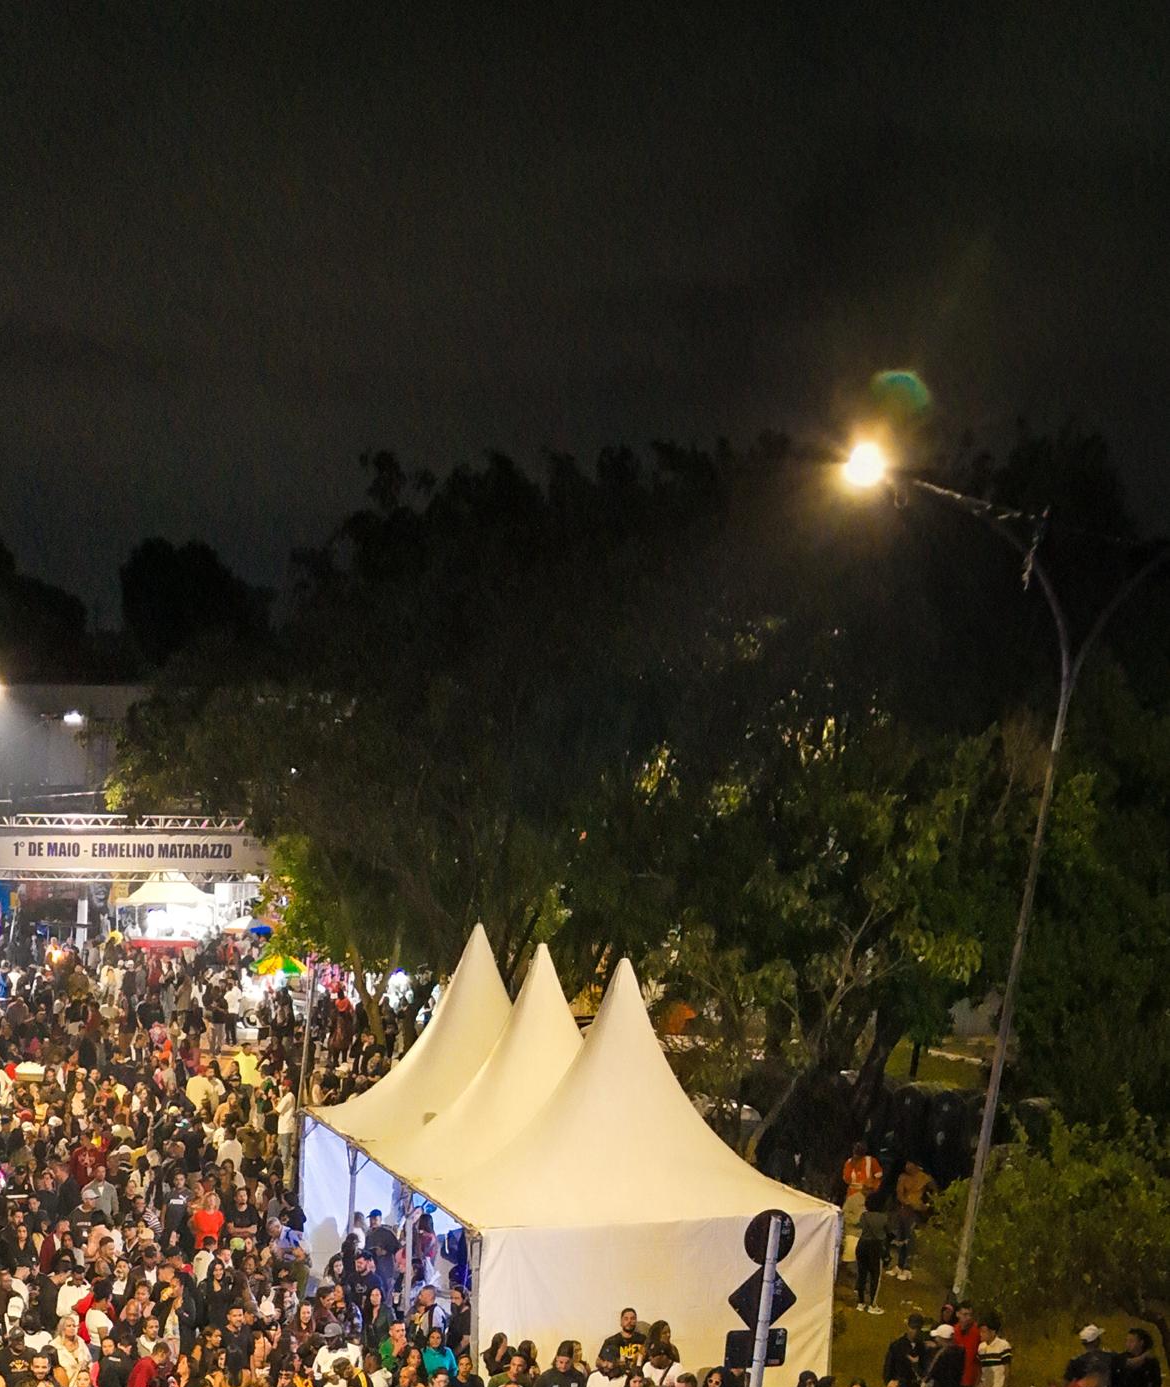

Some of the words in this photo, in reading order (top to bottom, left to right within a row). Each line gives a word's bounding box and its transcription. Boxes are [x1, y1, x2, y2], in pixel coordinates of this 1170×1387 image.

[28, 841, 44, 857] DE
[47, 841, 80, 858] MAIO
[91, 842, 154, 859] ERMELINO
[157, 843, 232, 860] MATARAZZO
